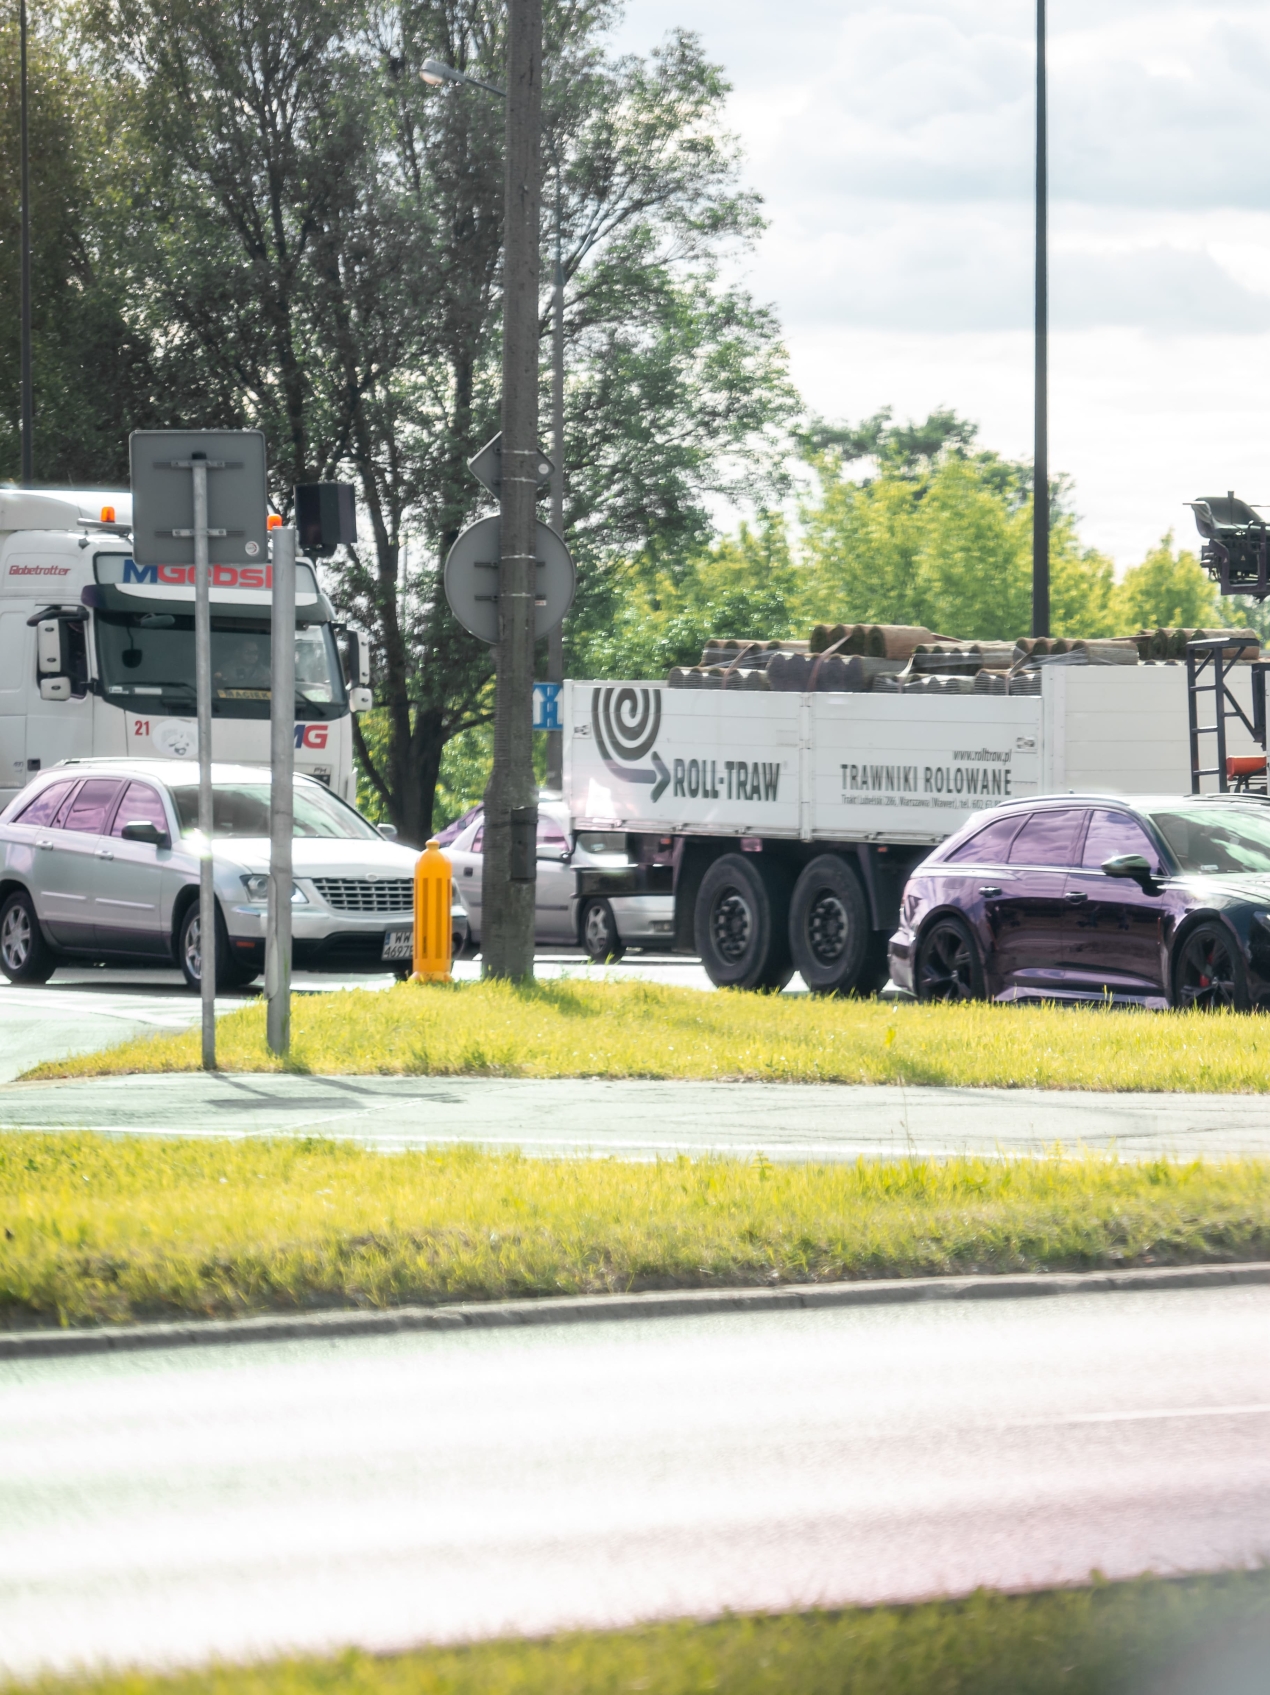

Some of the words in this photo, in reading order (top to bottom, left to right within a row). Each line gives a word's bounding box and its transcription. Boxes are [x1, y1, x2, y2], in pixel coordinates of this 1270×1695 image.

[9, 565, 71, 575] Globetrotter
[134, 720, 149, 736] 21
[673, 758, 781, 801] ROLL-TRAW
[840, 764, 918, 792] TRAWNIKI
[924, 766, 1012, 795] ROLOWANE
[395, 932, 410, 944] WW
